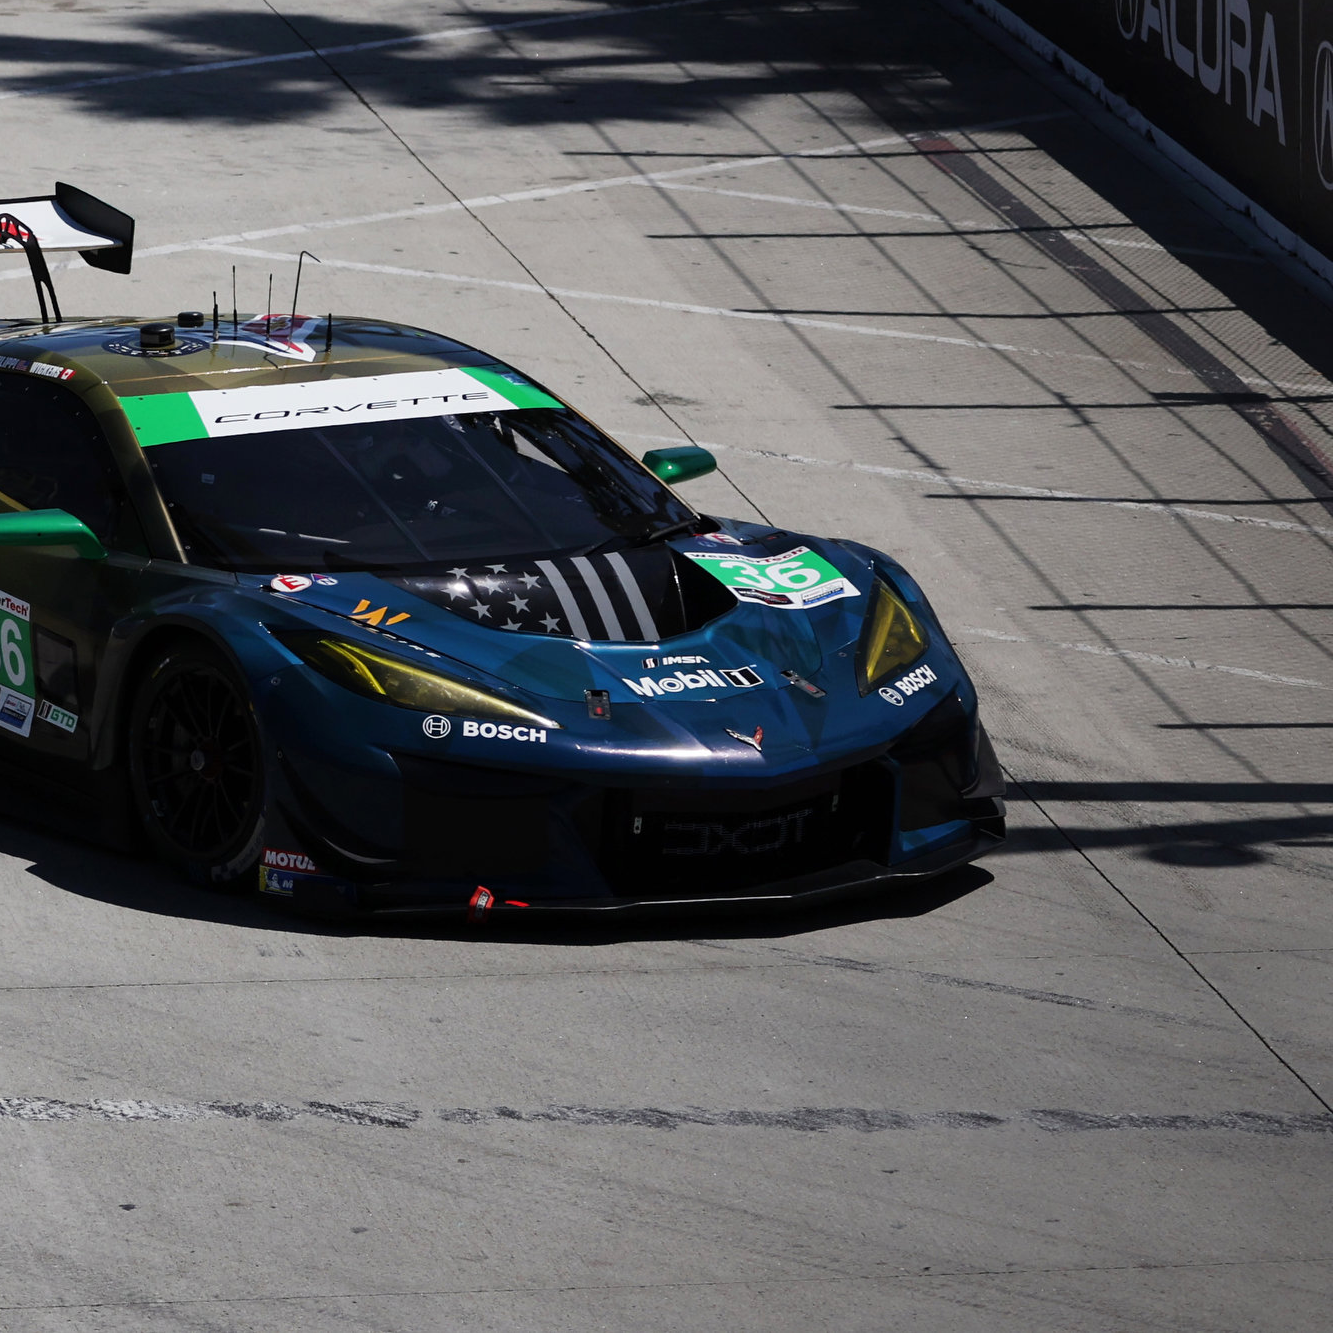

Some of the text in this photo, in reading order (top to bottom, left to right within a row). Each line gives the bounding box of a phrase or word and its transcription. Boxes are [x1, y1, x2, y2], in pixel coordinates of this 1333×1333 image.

[30, 361, 64, 378] WICKERS
[214, 390, 490, 424] CORVETTE
[690, 547, 803, 564] WeatherTech
[719, 560, 821, 590] 36
[663, 656, 710, 665] IMSA
[621, 669, 728, 697] Mobil
[894, 664, 937, 696] BOSCH
[50, 709, 76, 728] GTD
[463, 720, 546, 743] BOSCH
[265, 850, 316, 871] MOTUL
